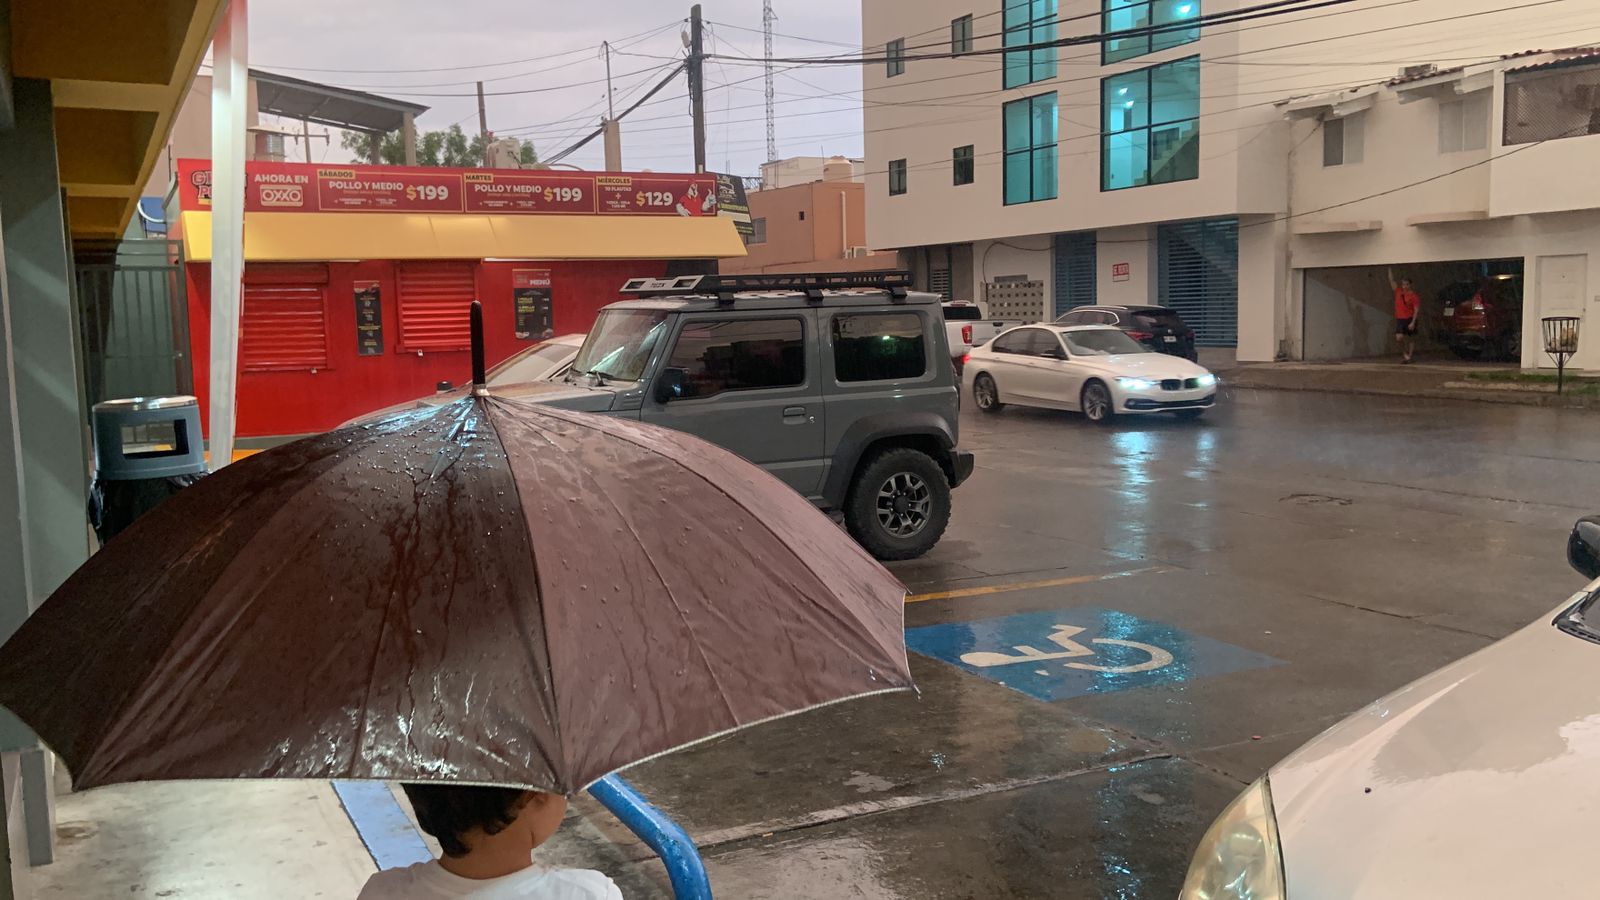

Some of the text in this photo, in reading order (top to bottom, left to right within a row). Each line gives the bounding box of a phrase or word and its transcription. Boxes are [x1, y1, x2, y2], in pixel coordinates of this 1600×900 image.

[254, 174, 309, 184] AHORA EN
[329, 181, 404, 191] POLLO Y MEDIO
[406, 185, 449, 200] $199
[474, 184, 502, 192] POLLO
[513, 185, 542, 193] MEDIO
[543, 187, 583, 202] $199
[262, 189, 301, 203] OXXO
[636, 191, 673, 206] $129
